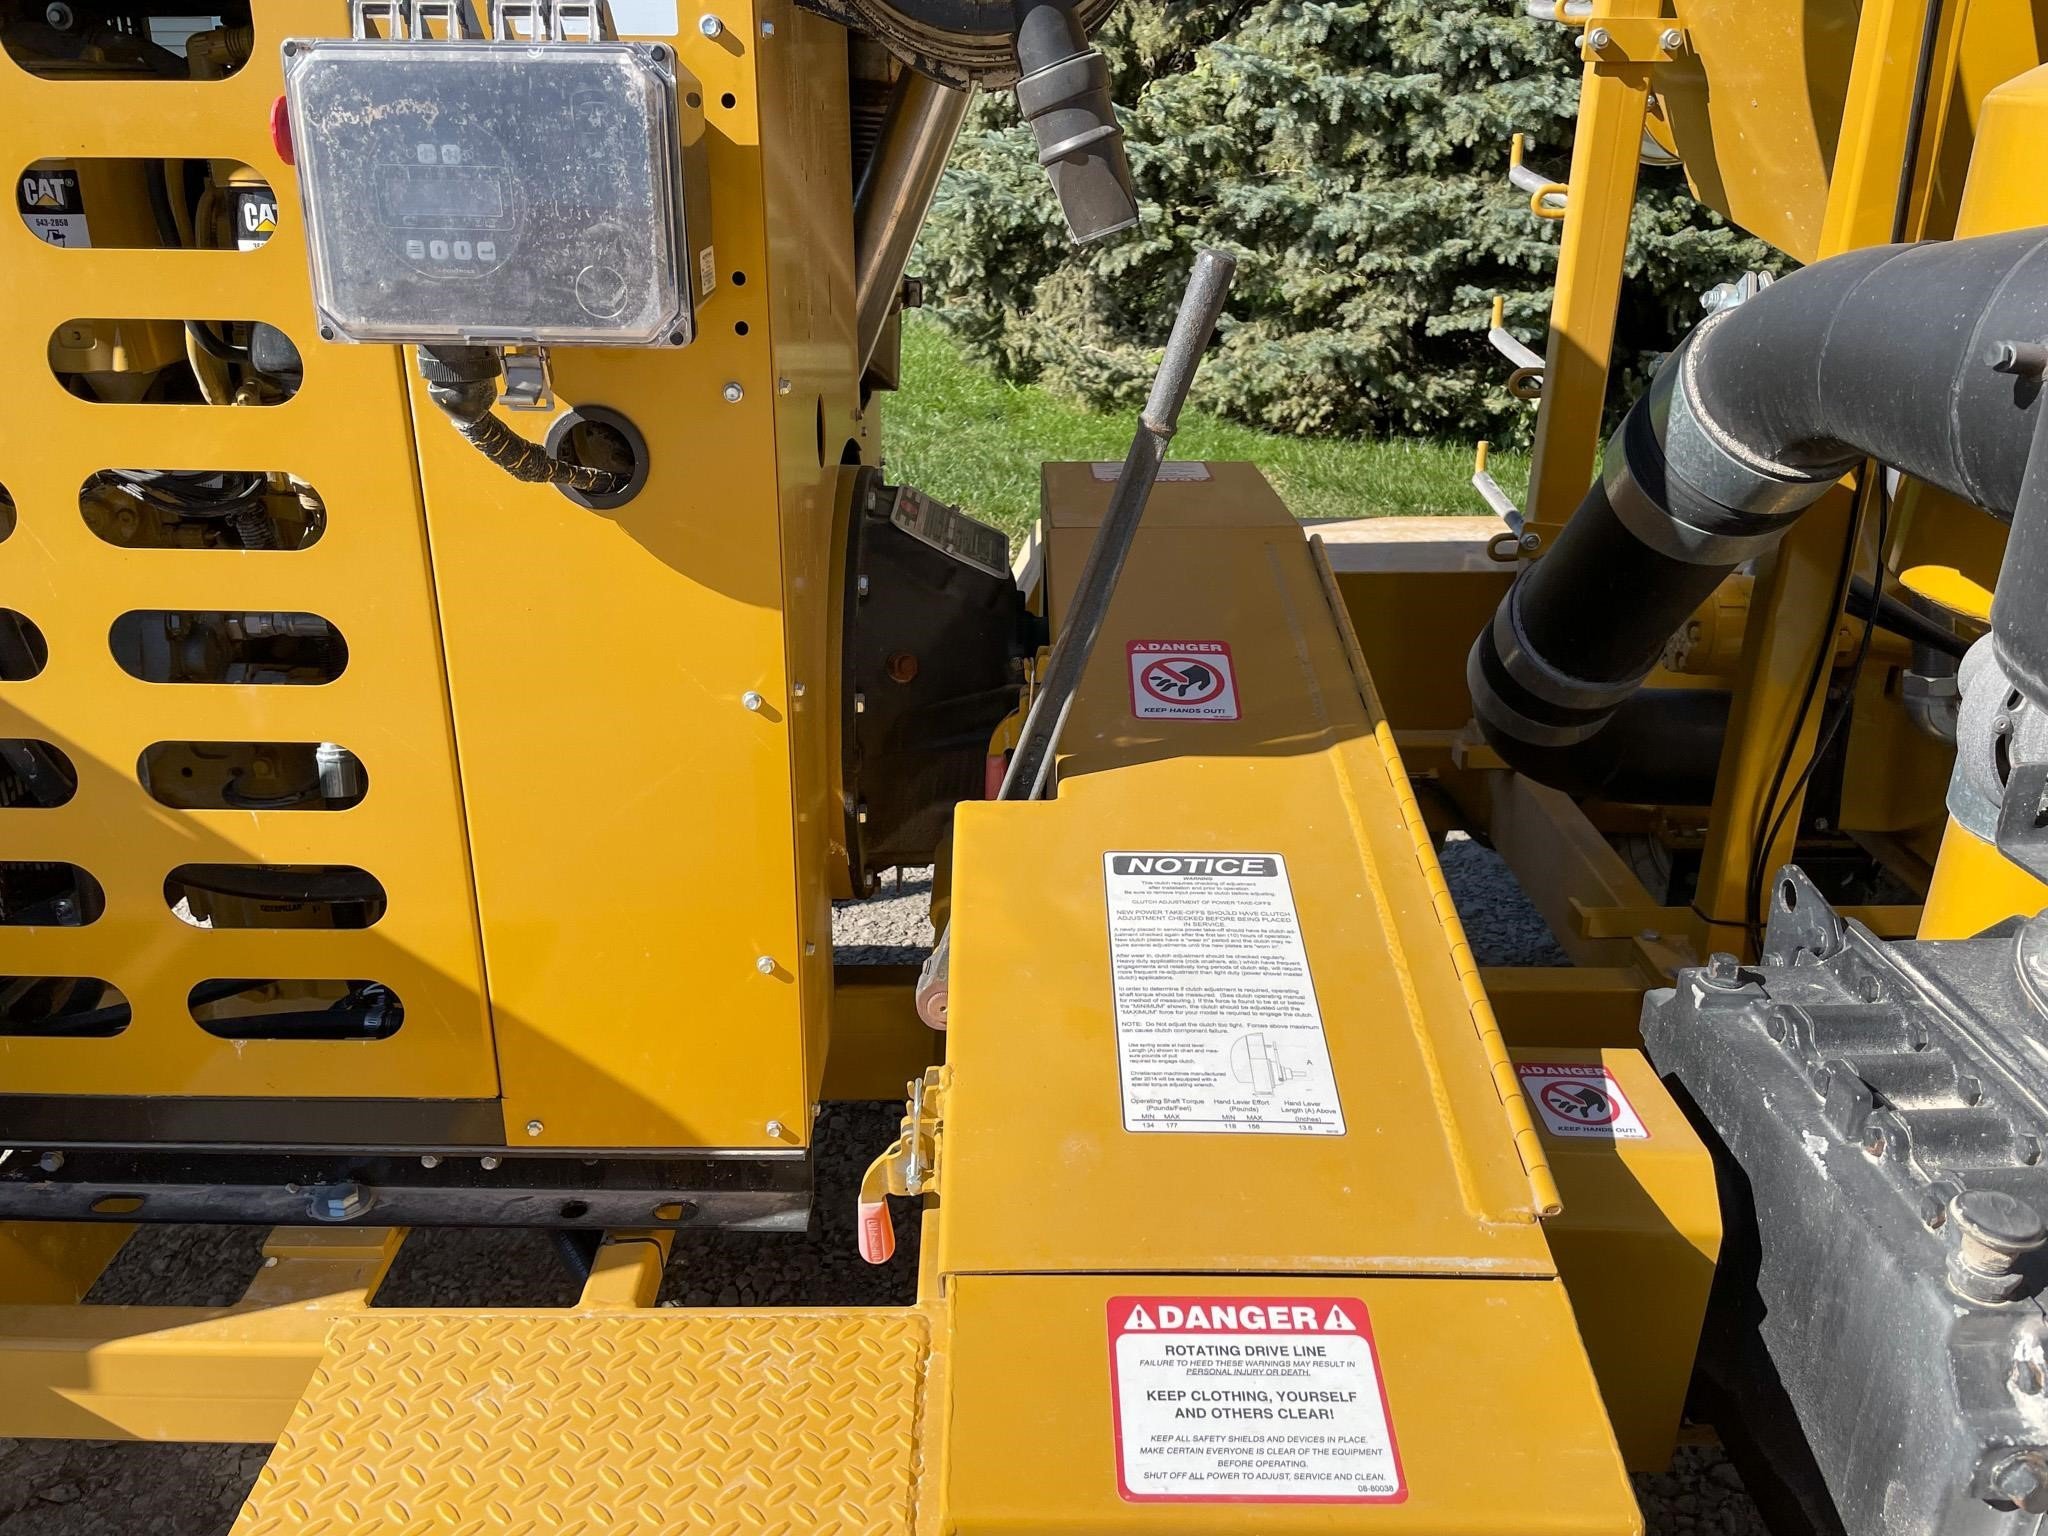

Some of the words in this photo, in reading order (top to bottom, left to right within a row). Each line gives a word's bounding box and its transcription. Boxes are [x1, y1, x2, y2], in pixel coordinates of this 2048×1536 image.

[244, 202, 277, 232] CA
[1148, 643, 1222, 652] DANGER
[1127, 857, 1265, 874] NOTICE
[1531, 1066, 1607, 1076] DANGER
[1305, 1107, 1315, 1115] (A)
[1158, 1305, 1319, 1330] DANGER
[1165, 1345, 1241, 1356] ROTATING
[1245, 1346, 1289, 1356] DRIVE
[1293, 1346, 1327, 1357] LINE
[1186, 1368, 1233, 1376] PERSONAL
[1147, 1390, 1186, 1401] KEEP
[1191, 1391, 1272, 1403] CLOTHING,
[1276, 1391, 1358, 1402] YOURSELF
[1175, 1408, 1207, 1419] AND
[1211, 1408, 1273, 1419] OTHERS
[1278, 1408, 1335, 1419] CLEAR!
[1193, 1435, 1226, 1443] SAFETY
[1255, 1460, 1309, 1468] OPERATING.
[1206, 1472, 1240, 1480] POWER
[1242, 1472, 1255, 1480] TO
[1255, 1473, 1291, 1481] ADJUST,
[1354, 1473, 1387, 1481] CLEAN.
